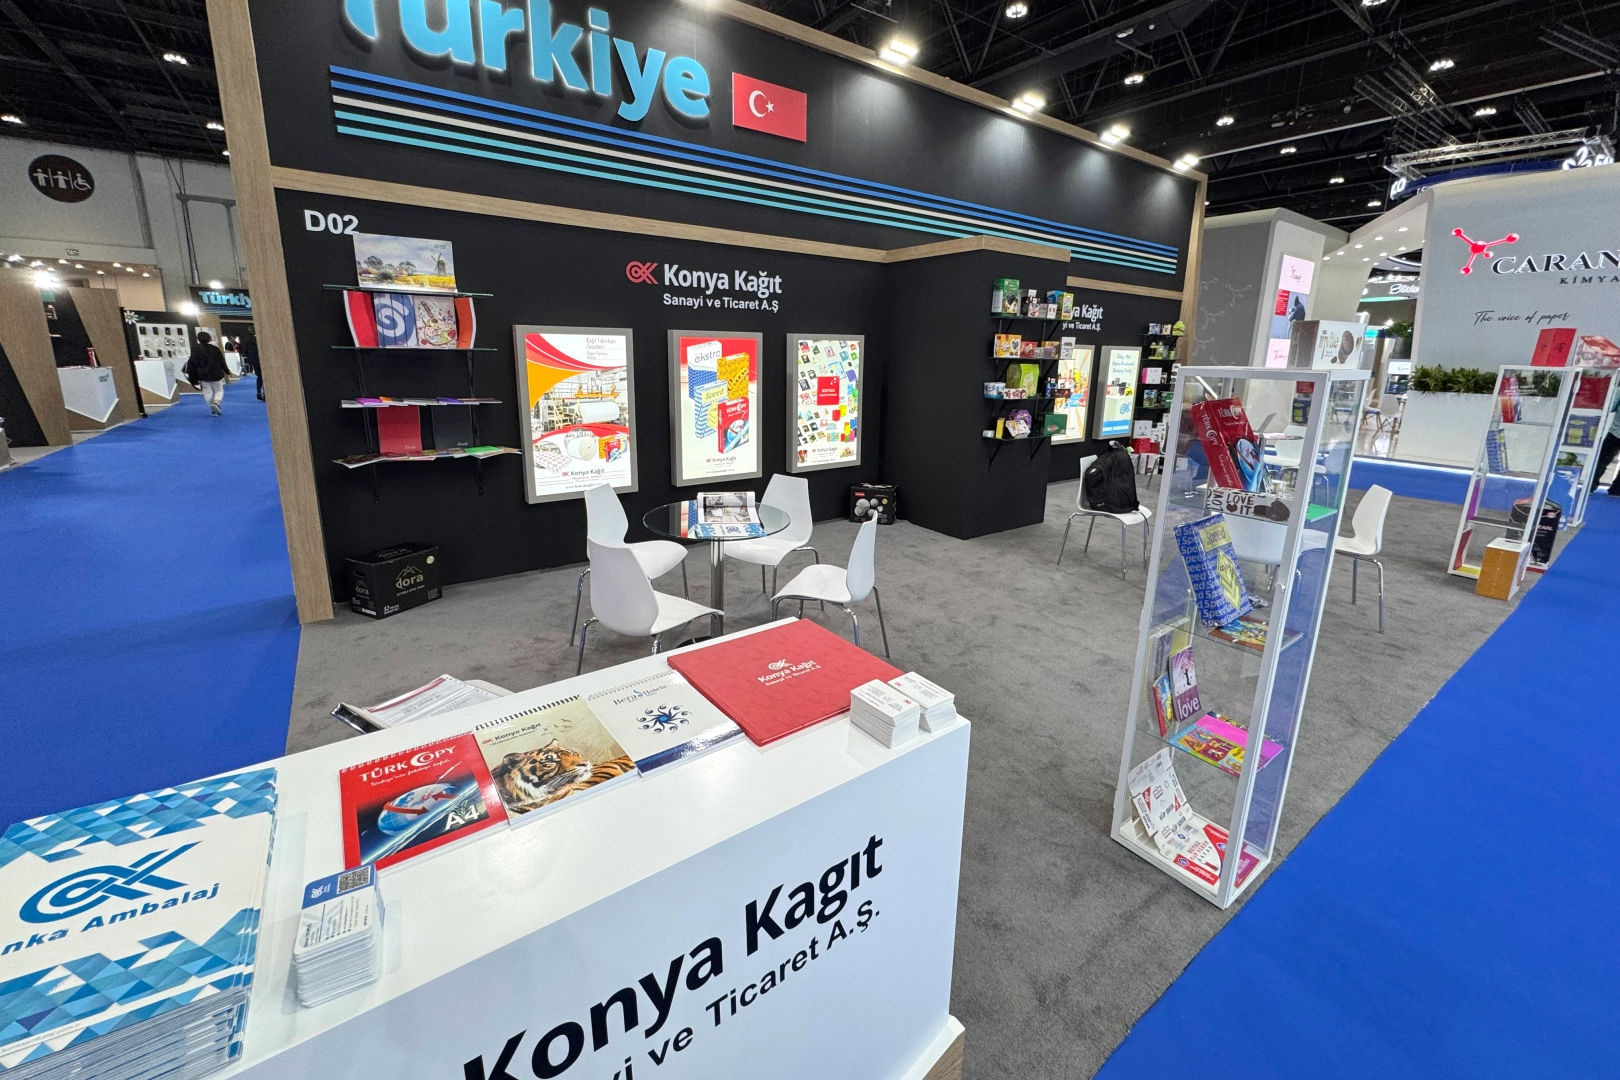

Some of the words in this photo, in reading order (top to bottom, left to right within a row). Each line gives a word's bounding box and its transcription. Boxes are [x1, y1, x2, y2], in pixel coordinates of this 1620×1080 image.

[304, 209, 360, 235] D02
[664, 263, 729, 295] Konya
[734, 270, 782, 299] Kağıt
[663, 293, 703, 309] Sanayi
[706, 299, 721, 308] ve
[722, 297, 759, 310] Ticaret
[761, 300, 779, 313] A.Ş
[1081, 304, 1103, 322] Kağıt
[1075, 321, 1091, 330] Ticaret
[1474, 310, 1495, 326] The
[1524, 311, 1538, 324] of
[1536, 312, 1570, 325] paper
[1226, 492, 1254, 506] LOVE
[1240, 505, 1251, 516] IT
[1205, 527, 1226, 546] Speed
[396, 573, 424, 589] dora
[757, 668, 791, 683] Konya
[790, 660, 817, 672] Kağıt
[613, 693, 637, 706] Bera
[642, 685, 668, 697] Hotels
[1177, 697, 1200, 719] love
[495, 730, 520, 741] Konya
[521, 722, 542, 733] Kağıt
[359, 760, 408, 782] TÜRK
[444, 804, 480, 831] A4
[80, 883, 220, 932] Ambalaj
[647, 1027, 694, 1066] ve
[705, 937, 819, 1027] Ticaret
[826, 899, 880, 950] A.Ş.
[463, 936, 724, 1080] Konya
